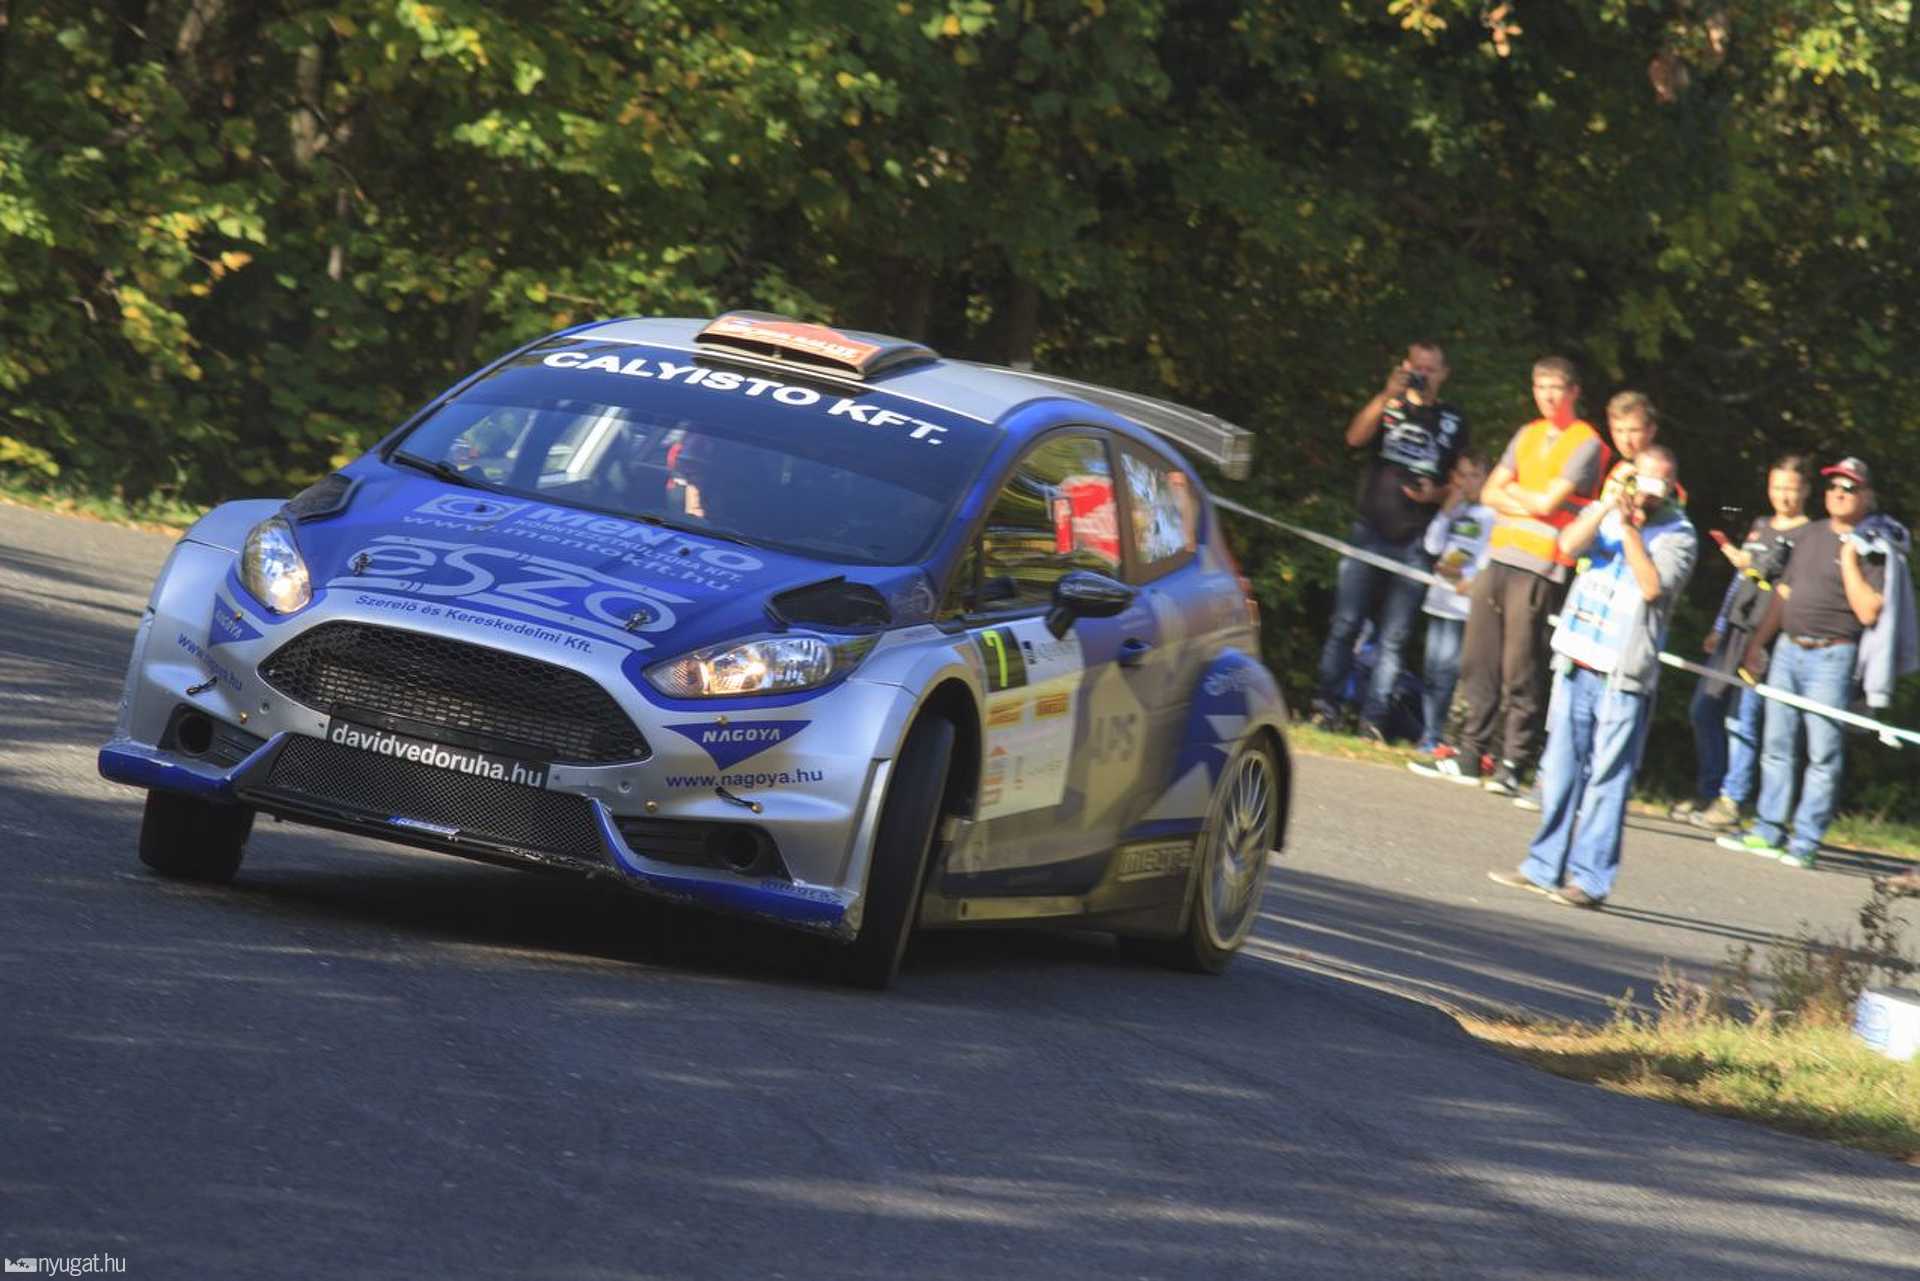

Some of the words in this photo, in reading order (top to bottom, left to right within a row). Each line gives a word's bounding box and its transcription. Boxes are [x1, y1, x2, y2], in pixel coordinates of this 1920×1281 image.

[543, 352, 821, 406] CALYISTO
[827, 398, 949, 446] KFT.
[446, 608, 561, 645] Kereskedelmi
[563, 634, 593, 654] Kft.
[981, 629, 1008, 689] 7
[332, 724, 545, 788] davidvedoruha.hu
[702, 728, 781, 744] NAGOYA
[665, 768, 824, 789] www.nagoya.hu
